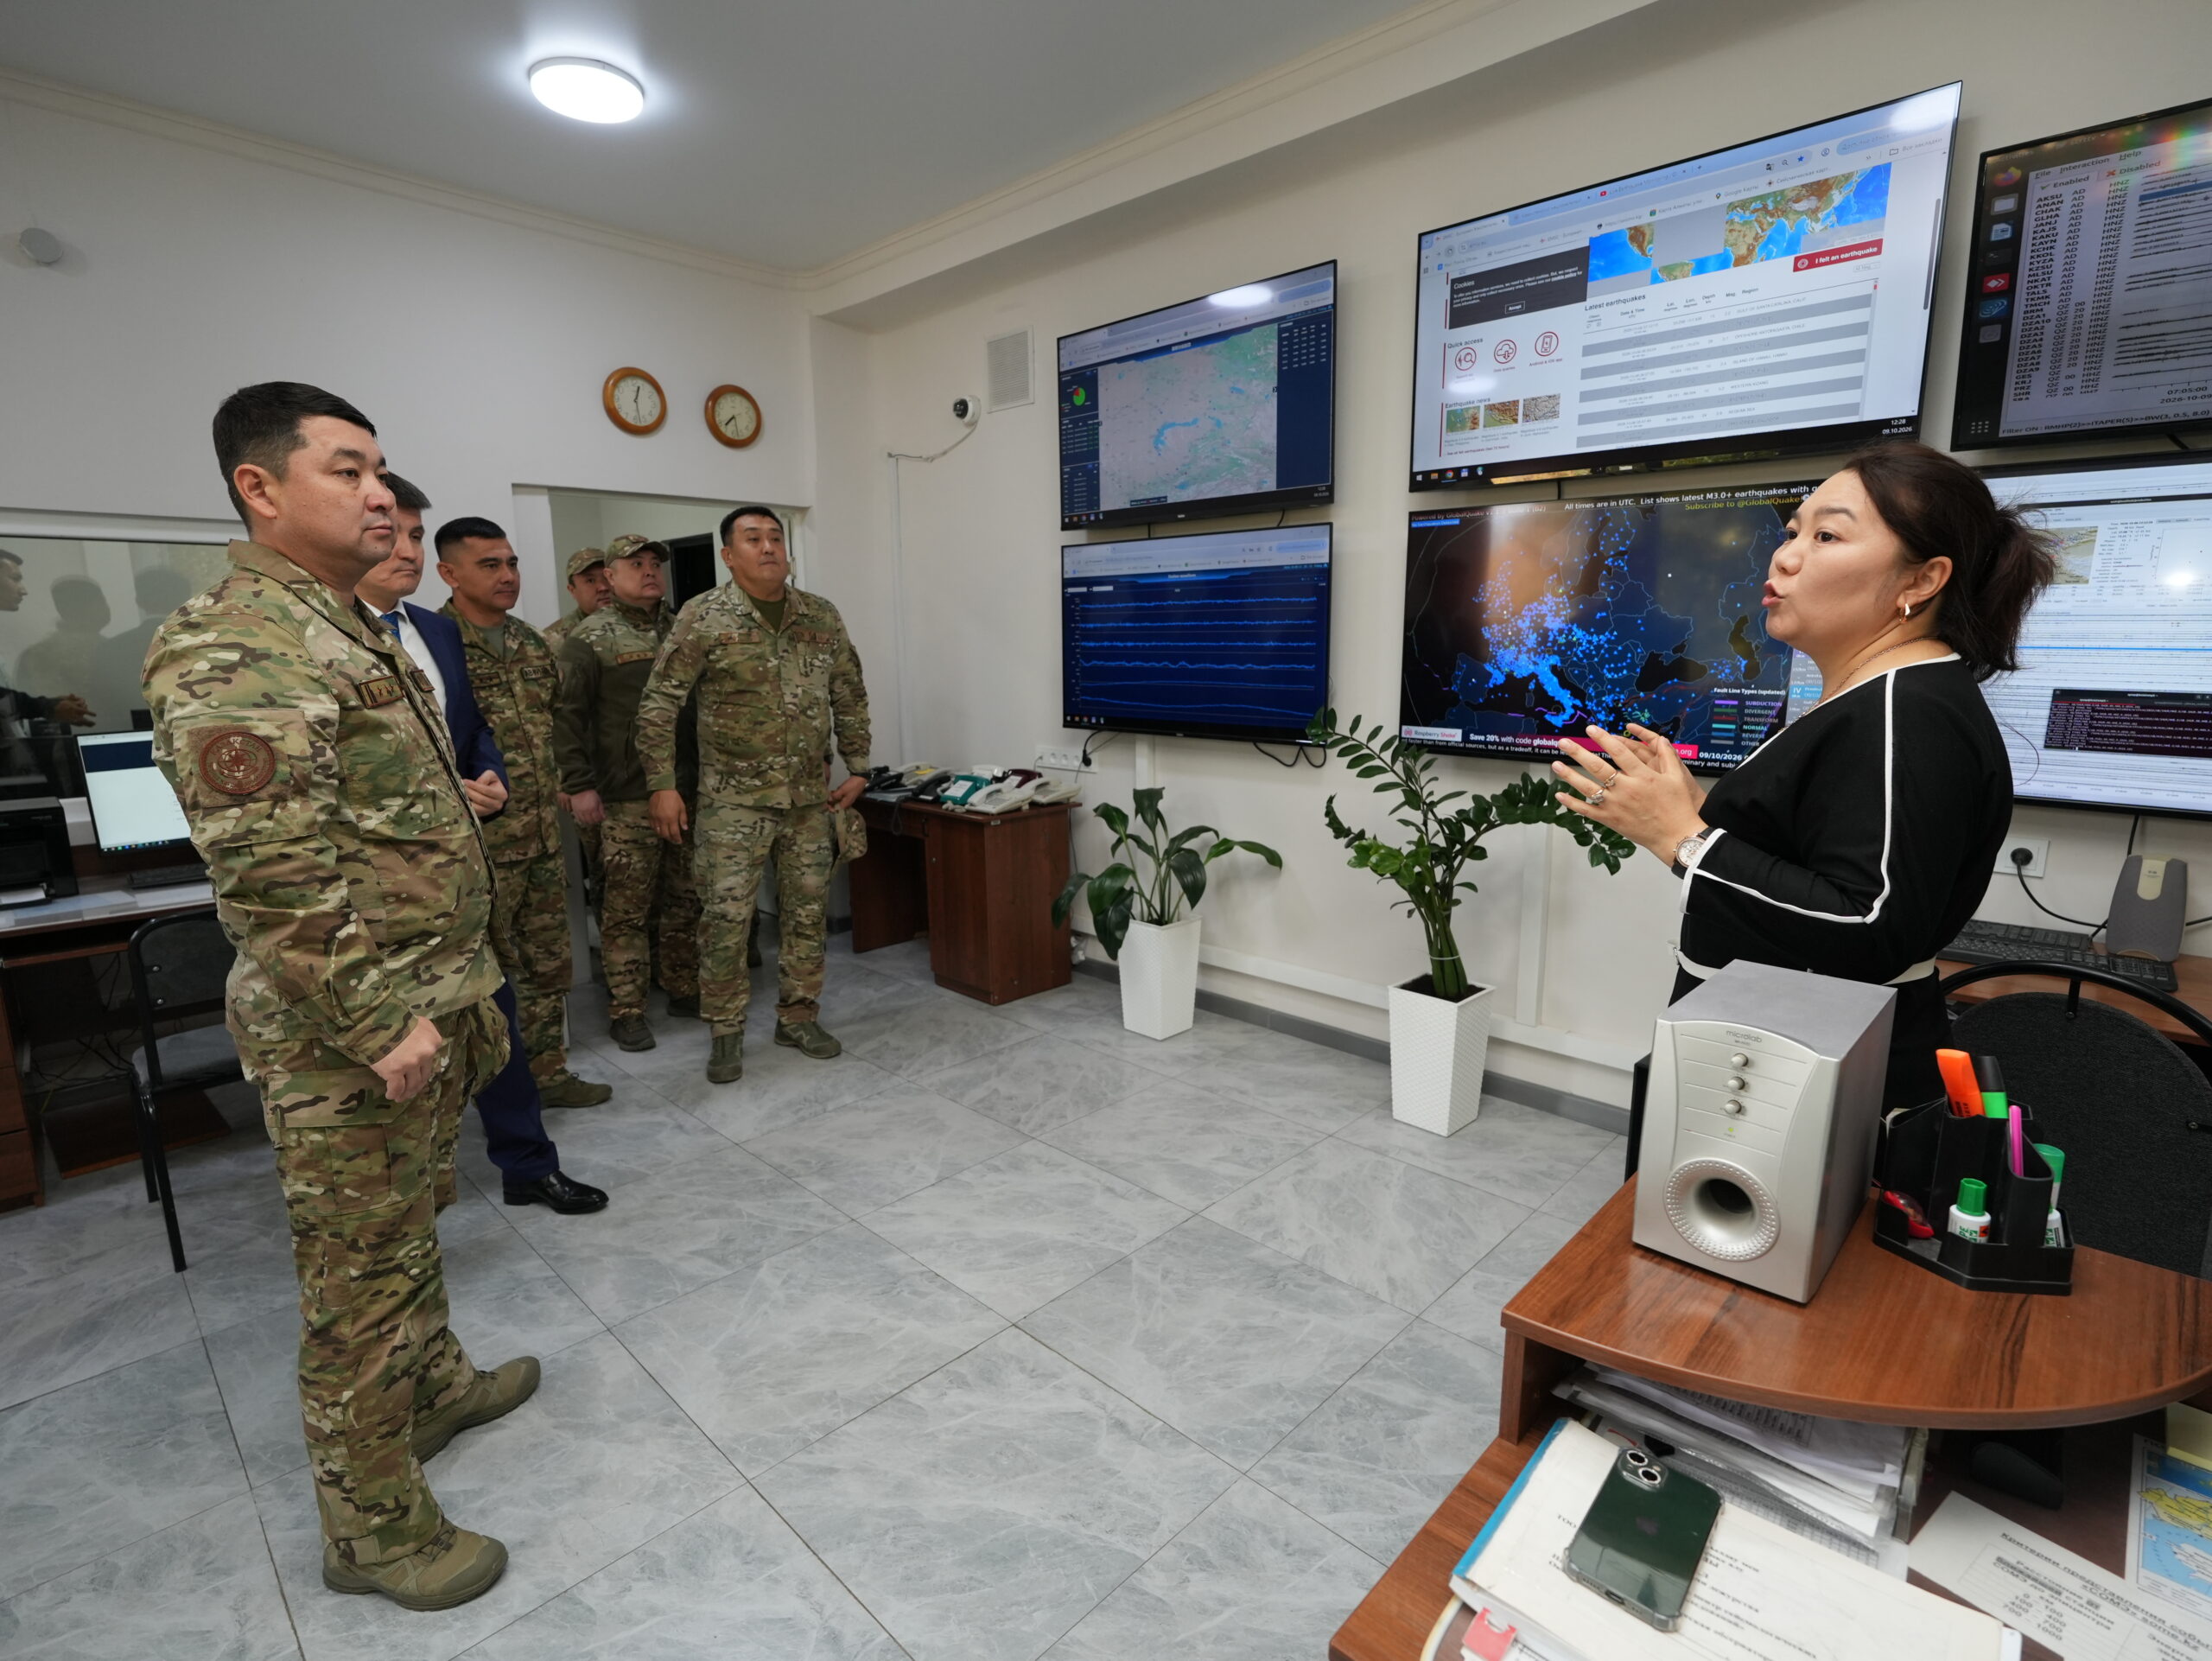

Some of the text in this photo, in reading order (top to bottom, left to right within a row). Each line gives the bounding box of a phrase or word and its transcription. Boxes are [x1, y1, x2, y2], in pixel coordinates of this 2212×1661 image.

[2035, 150, 2142, 179] File Interaction Help
[2053, 160, 2161, 188] Enabled Disabled
[2036, 200, 2063, 209] ANAN
[2108, 186, 2129, 194] HNZ
[2037, 194, 2063, 203] AKSU
[2035, 207, 2062, 216] CHAK
[2107, 193, 2128, 201] HNZ
[2031, 239, 2056, 247] KAYN
[2032, 232, 2058, 241] KAKU
[1819, 255, 1830, 264] felt
[1840, 246, 1878, 259] earthquake
[2028, 270, 2053, 278] MLSU
[1453, 280, 1475, 290] Cookies
[1585, 294, 1646, 311] Latest earthquakes
[1447, 337, 1484, 349] Quick access
[2167, 386, 2208, 395] 07:05:00
[1445, 399, 1475, 409] Earthquake
[2160, 394, 2212, 404] 2026-10-09
[1882, 426, 1913, 435] 09.10.2026
[1656, 495, 1680, 504] shows
[1681, 493, 1704, 501] latest
[1706, 491, 1732, 500] M3.0+
[1734, 487, 1788, 499] earthquakes
[1790, 485, 1809, 493] with
[1685, 501, 1725, 511] Subscribe
[1533, 738, 1559, 748] globalq
[1699, 752, 1743, 761] 09/10/2026
[1726, 1030, 1763, 1043] microlab
[2000, 1532, 2061, 1567] Критерии
[2063, 1566, 2166, 1625] представления
[2016, 1560, 2083, 1600] Расстояние
[1993, 1562, 2111, 1631] СОМЭ до эпицентра
[2039, 1595, 2054, 1605] км
[2015, 1595, 2067, 1627] 100 400
[2044, 1605, 2063, 1618] 100
[2065, 1595, 2115, 1625] станции
[2003, 1604, 2063, 1641] 700 1000
[2009, 1601, 2063, 1633] 400 700
[2081, 1584, 2200, 1652] «СОМЭ» some.kz
